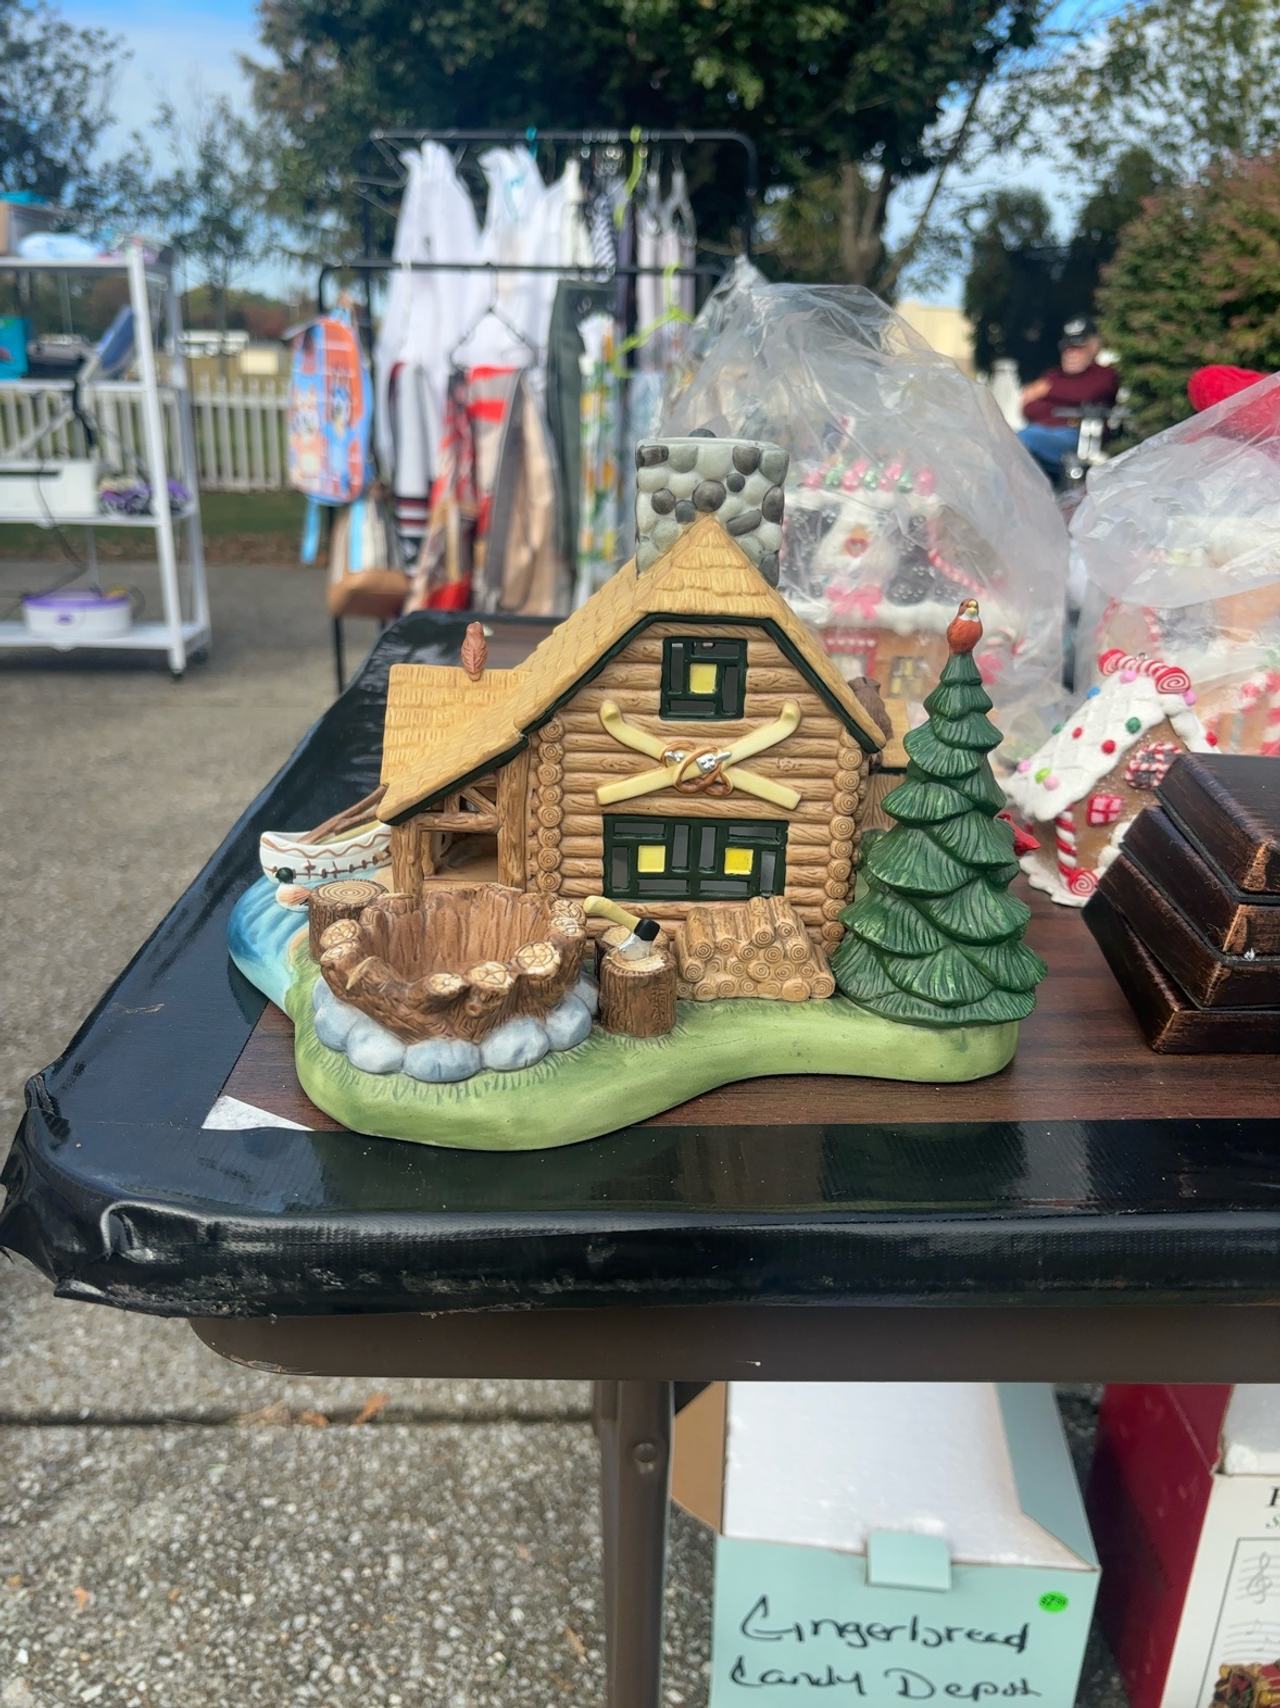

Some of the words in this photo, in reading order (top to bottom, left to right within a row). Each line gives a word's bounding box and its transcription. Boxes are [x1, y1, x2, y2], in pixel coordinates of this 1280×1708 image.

[740, 1595, 1030, 1654] Gingerbread
[730, 1656, 867, 1697] Candy
[884, 1668, 1042, 1701] Depot
